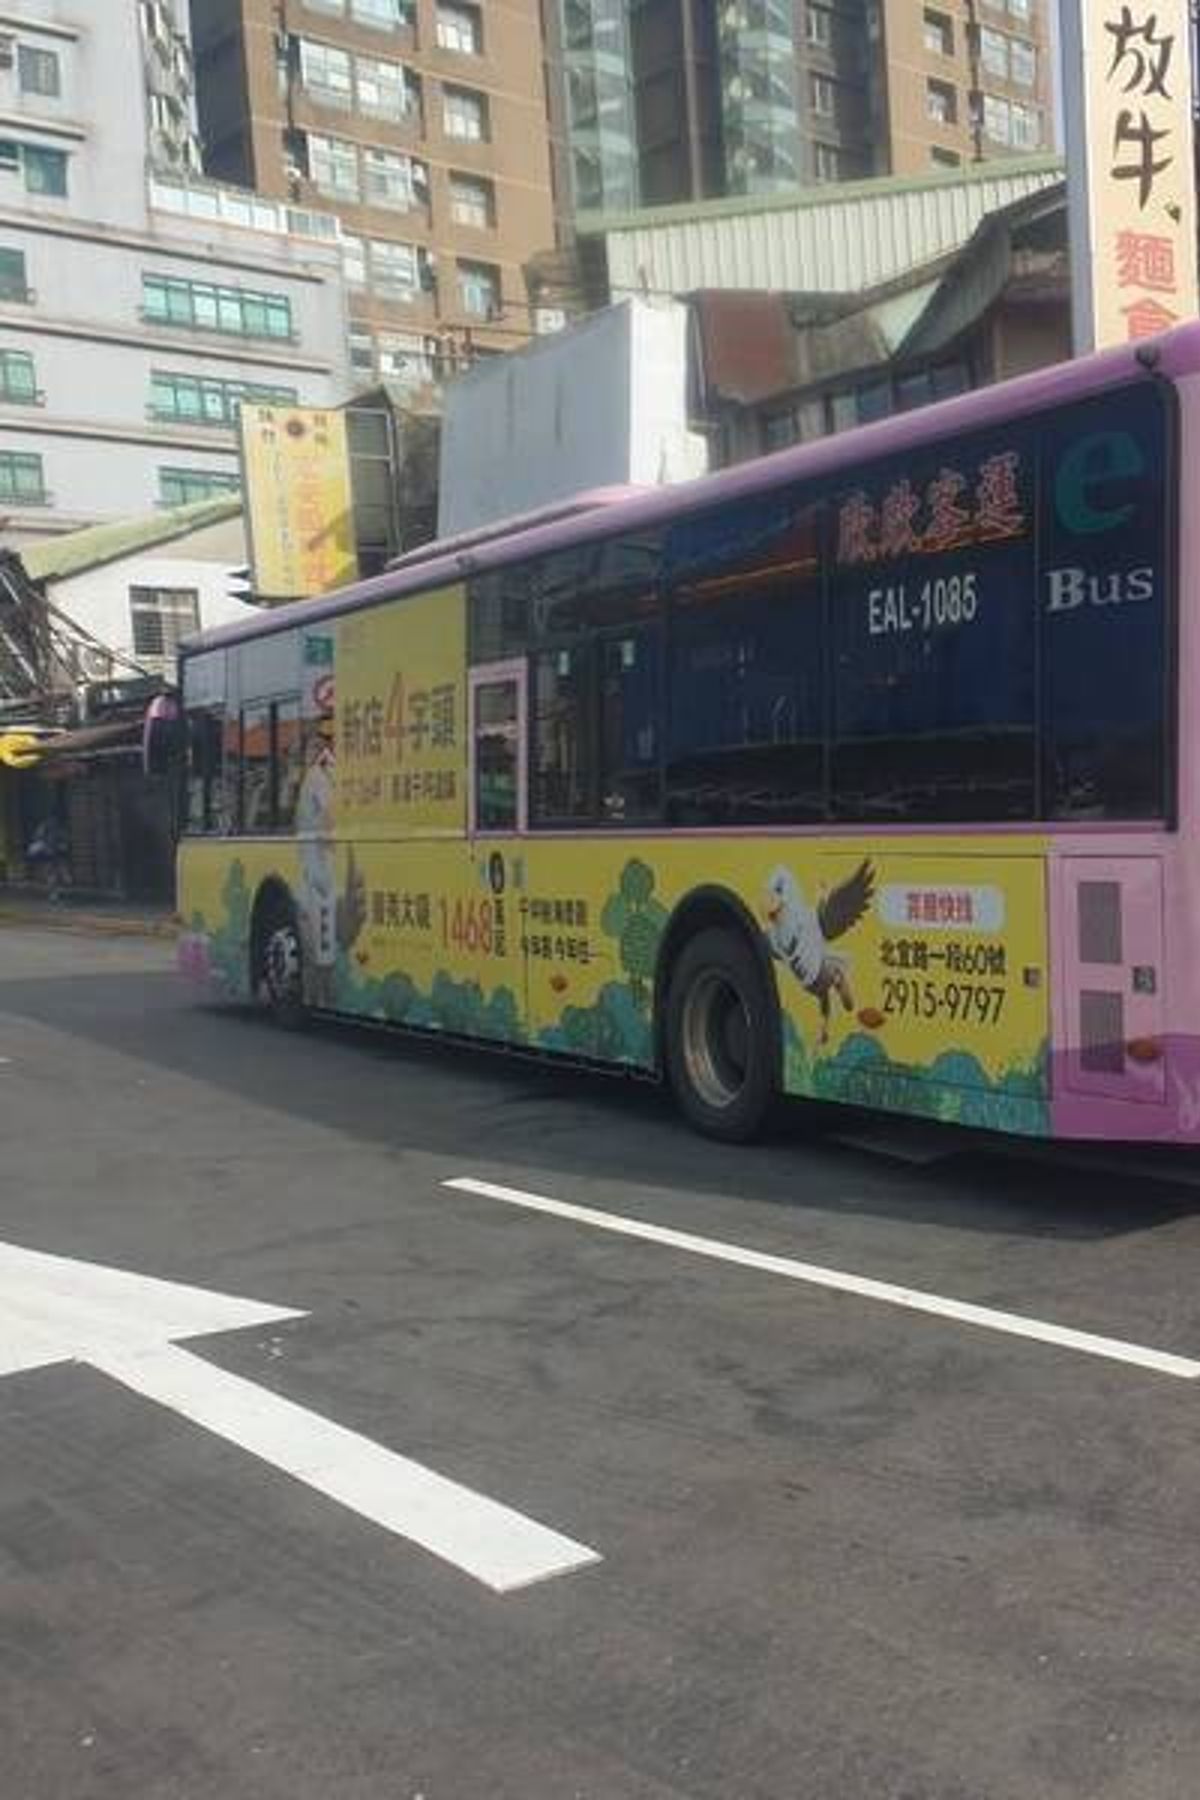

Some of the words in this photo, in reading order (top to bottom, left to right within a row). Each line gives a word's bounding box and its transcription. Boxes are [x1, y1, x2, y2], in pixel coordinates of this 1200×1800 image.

[868, 574, 978, 635] EAL-1085
[1046, 567, 1154, 612] Bus
[881, 977, 1006, 1026] 2915-9797
